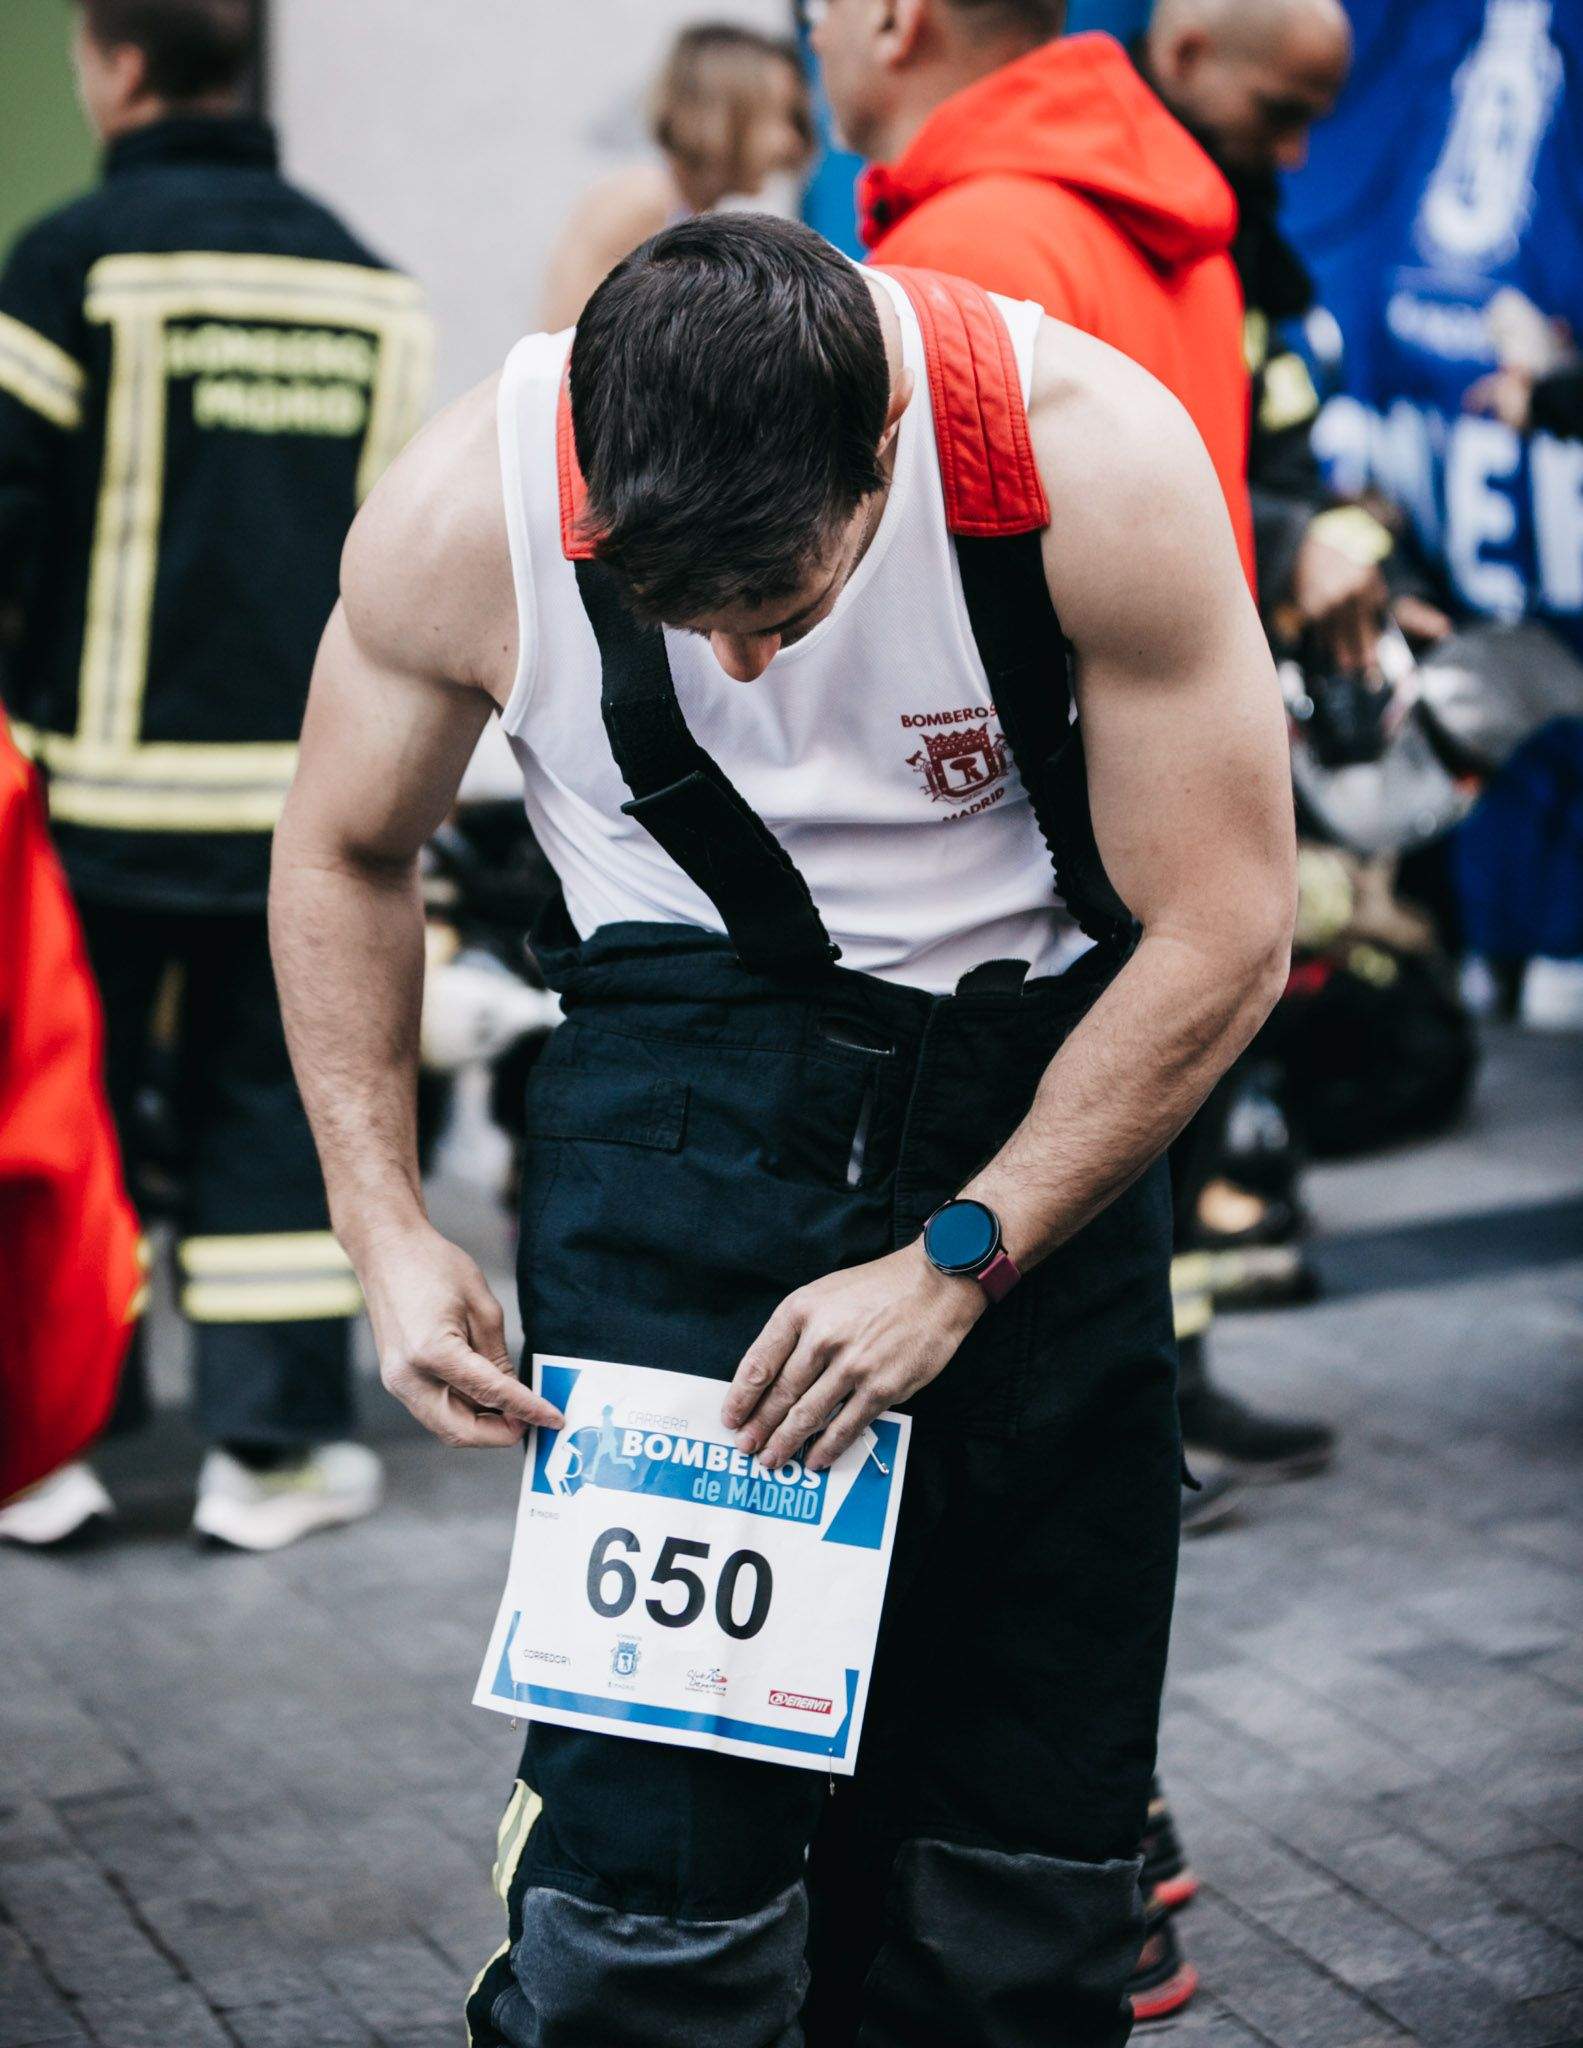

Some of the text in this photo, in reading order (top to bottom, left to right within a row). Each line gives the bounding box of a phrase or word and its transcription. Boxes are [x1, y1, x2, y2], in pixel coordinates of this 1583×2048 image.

[901, 704, 997, 728] BOMBEROS
[627, 1410, 689, 1432] CARRERA
[692, 1471, 819, 1520] de MADRID
[586, 1526, 774, 1641] 650
[785, 1695, 830, 1712] ENERVIT
